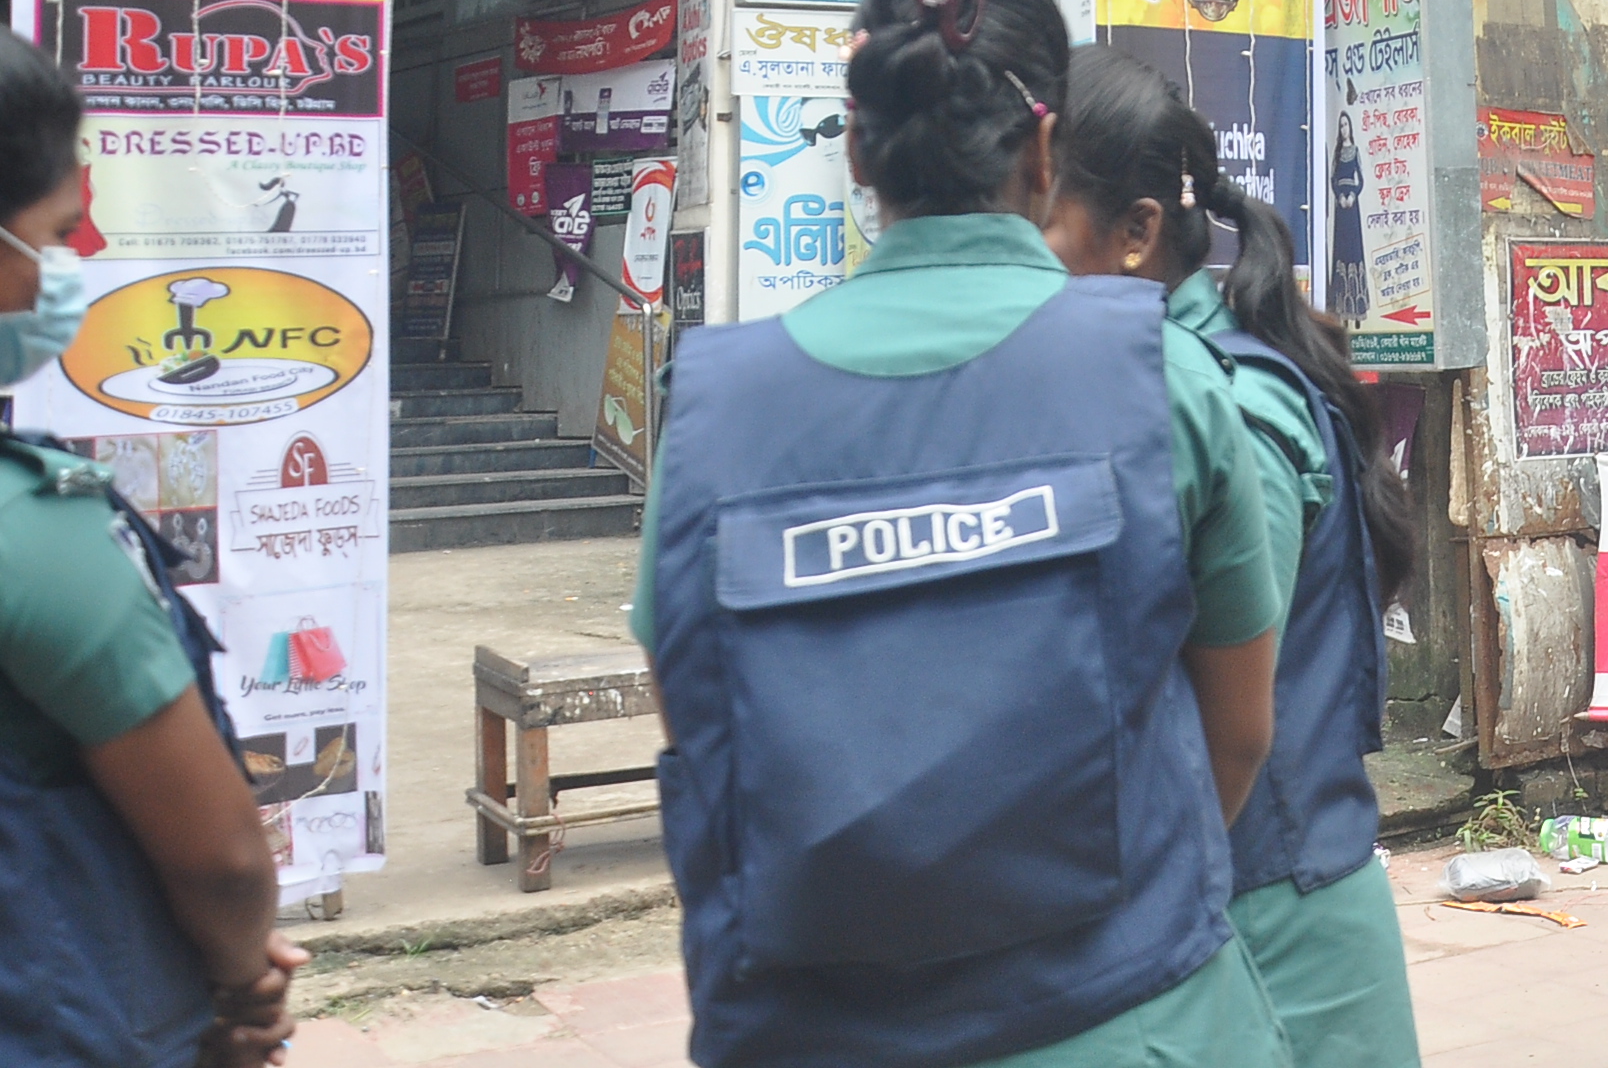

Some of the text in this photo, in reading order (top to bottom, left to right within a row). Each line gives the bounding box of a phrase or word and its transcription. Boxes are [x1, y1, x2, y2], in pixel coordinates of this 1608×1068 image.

[82, 74, 292, 88] BEAUTY PARLOUR
[99, 128, 367, 157] DRESSED-UP.BD
[1209, 122, 1266, 161] uchka
[1489, 110, 1536, 149] ইকবাল
[1218, 167, 1275, 205] stival
[221, 326, 342, 354] NFC
[188, 377, 251, 393] Nandan
[252, 369, 286, 384] Food
[155, 399, 295, 420] 01845-107455
[250, 495, 360, 524] SHAJEDA FOODS
[827, 505, 1014, 570] POLICE
